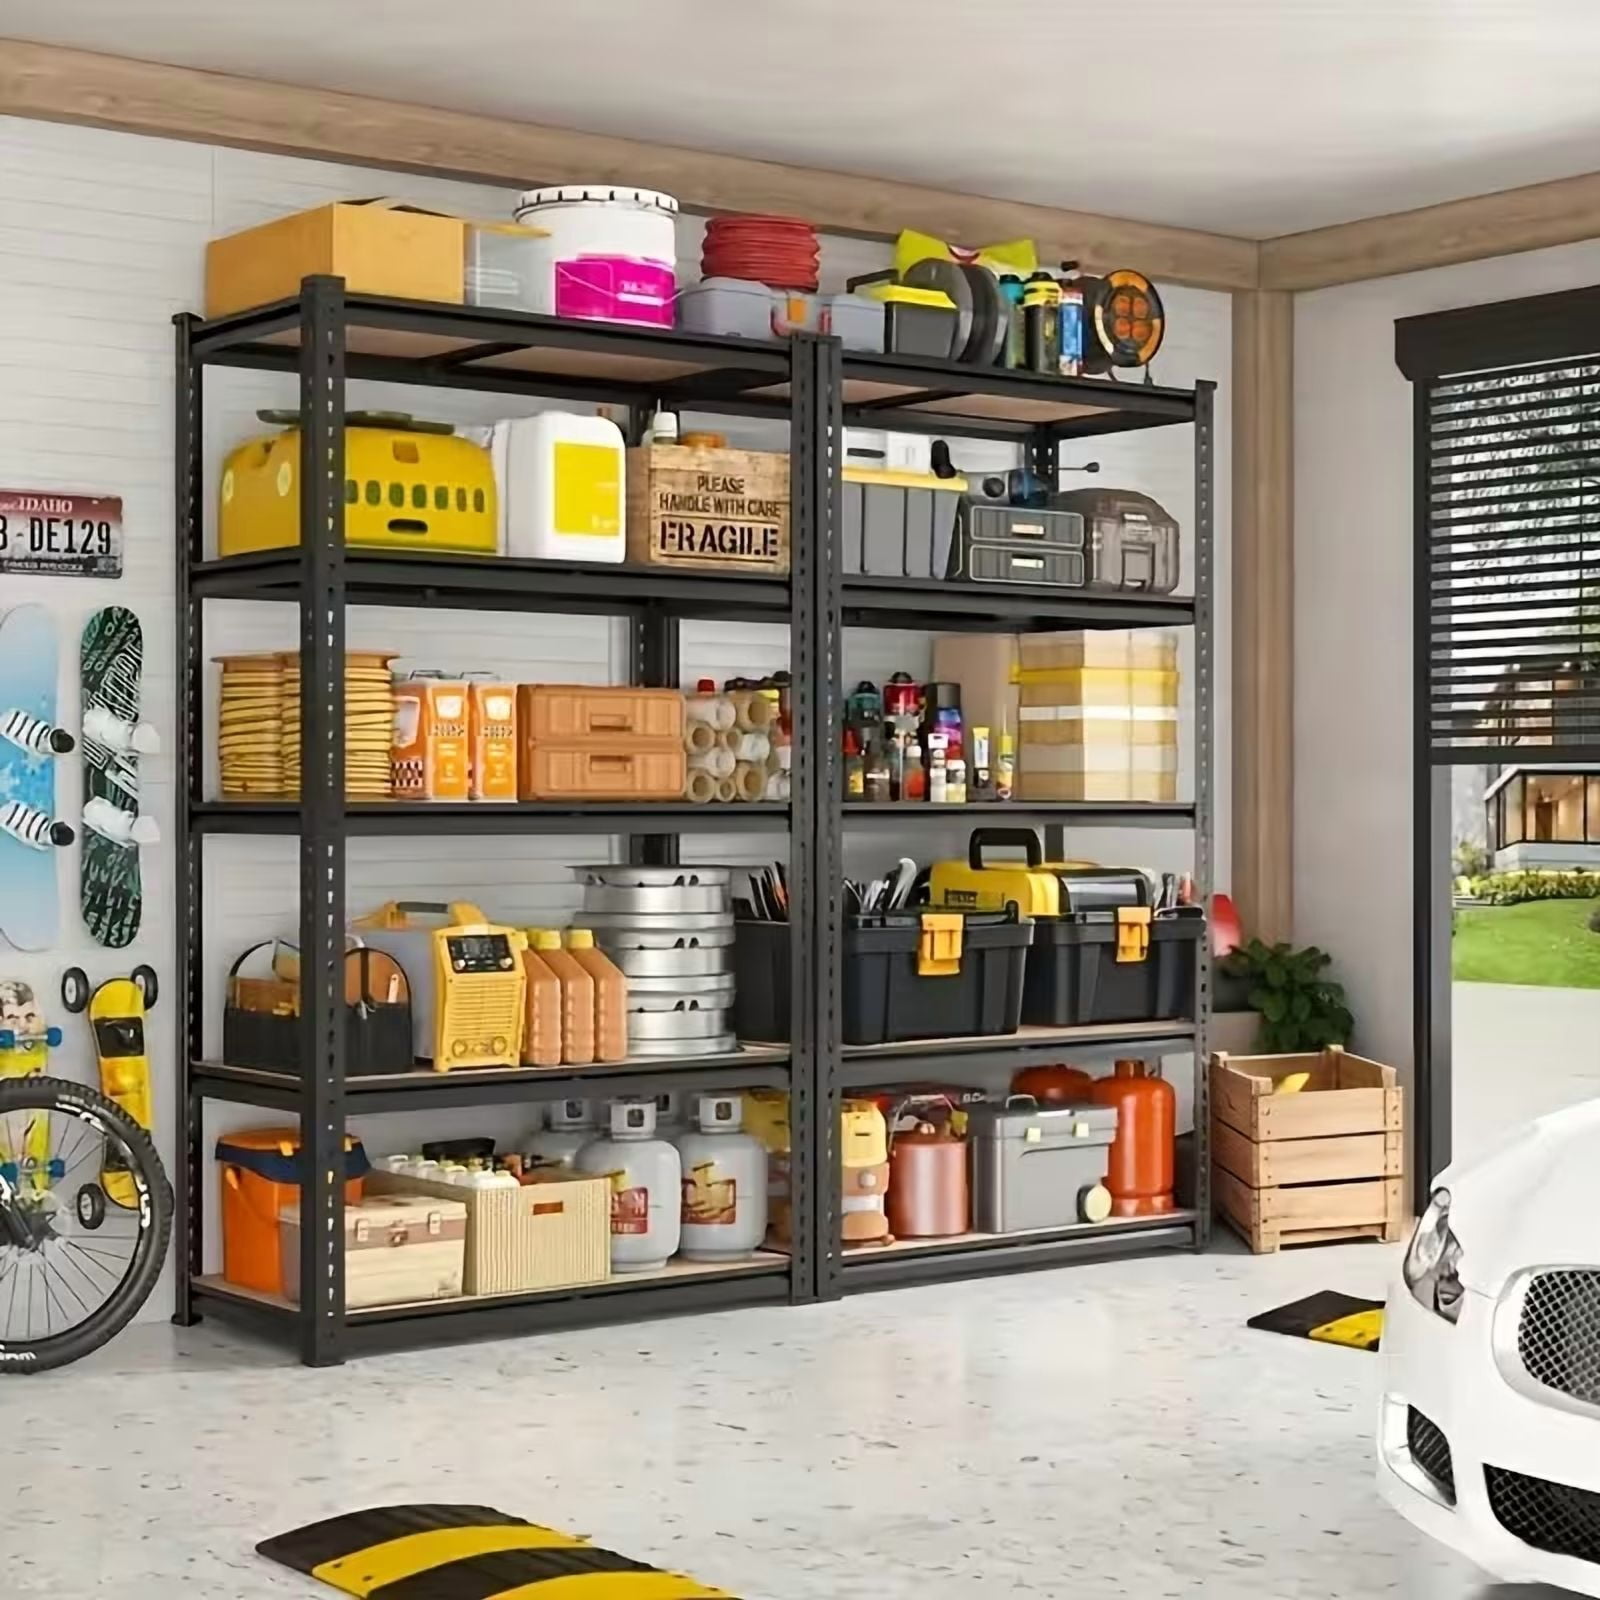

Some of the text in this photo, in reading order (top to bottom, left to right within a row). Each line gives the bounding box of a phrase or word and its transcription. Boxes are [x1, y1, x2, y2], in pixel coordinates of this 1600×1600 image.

[697, 475, 745, 495] PLEASE
[19, 497, 73, 513] IDAHO
[659, 492, 781, 518] HANDLE WITH CARE
[659, 521, 779, 557] FRAGILE
